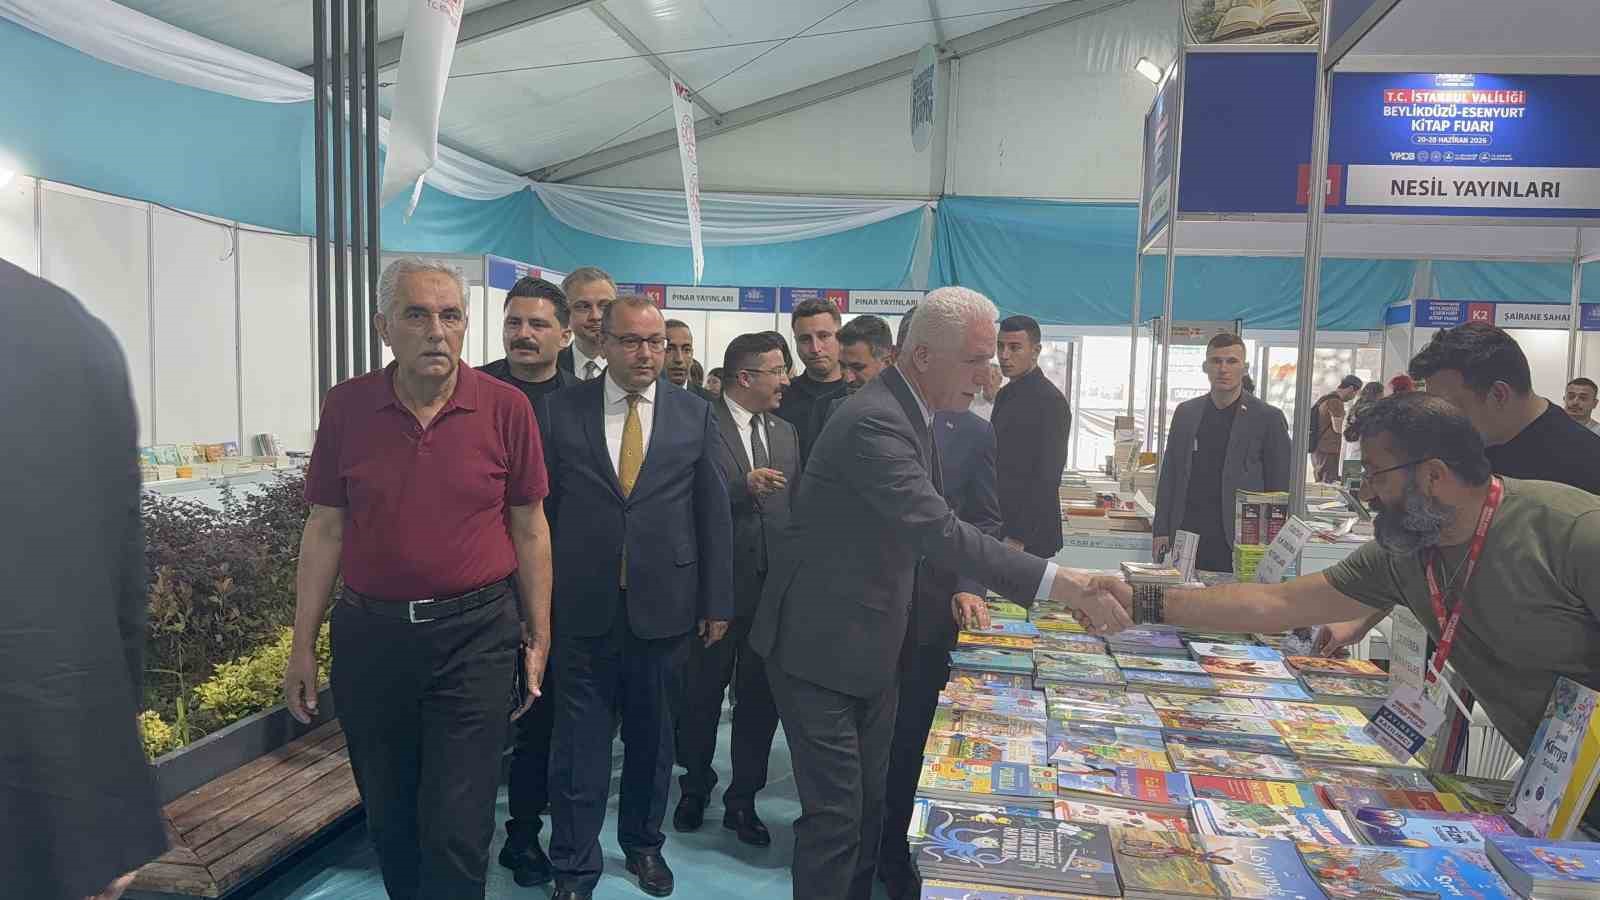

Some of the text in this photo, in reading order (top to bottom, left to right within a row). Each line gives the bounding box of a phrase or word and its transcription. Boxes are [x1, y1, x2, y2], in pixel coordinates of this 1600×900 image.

[1387, 92, 1407, 102] T.C.
[1472, 90, 1523, 103] VALİLİĞİ
[1384, 104, 1525, 118] BEYLİKDÜZÜ-ESENYURT
[1454, 120, 1494, 132] FUARI
[1391, 177, 1560, 198] NESİL YAYINLARI
[697, 294, 733, 302] YAYINLARI
[855, 296, 877, 305] PINAR
[1473, 310, 1488, 320] K2
